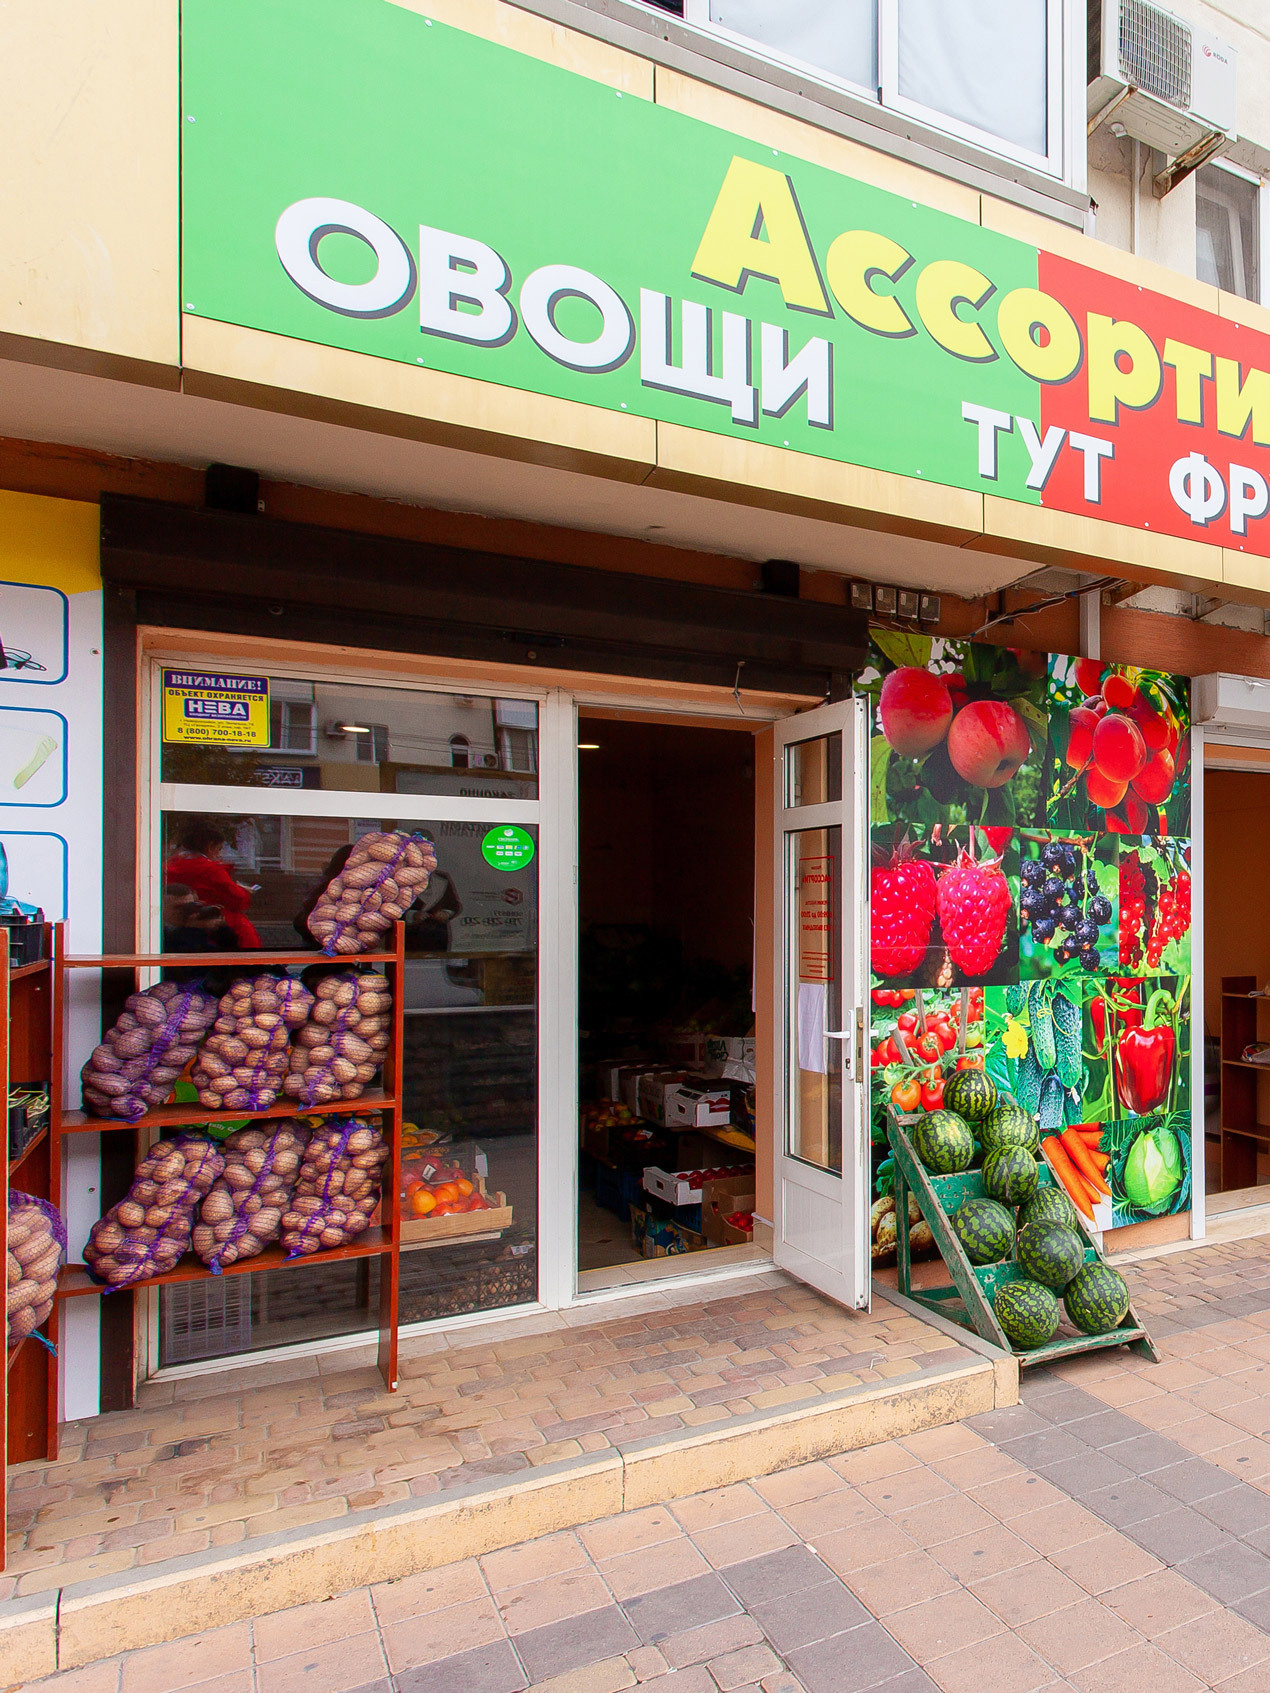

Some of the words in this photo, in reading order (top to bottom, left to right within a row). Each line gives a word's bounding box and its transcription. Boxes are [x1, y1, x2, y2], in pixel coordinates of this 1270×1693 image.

[275, 197, 833, 431] ОВОЩИ
[962, 401, 1115, 503] ТУТ
[168, 689, 205, 699] ОБЪЕКТ
[206, 691, 264, 702] ОХРАНЯЕТСЯ
[188, 700, 247, 716] НЕВА
[186, 728, 210, 736] (800)
[212, 729, 257, 738] 700-18-18
